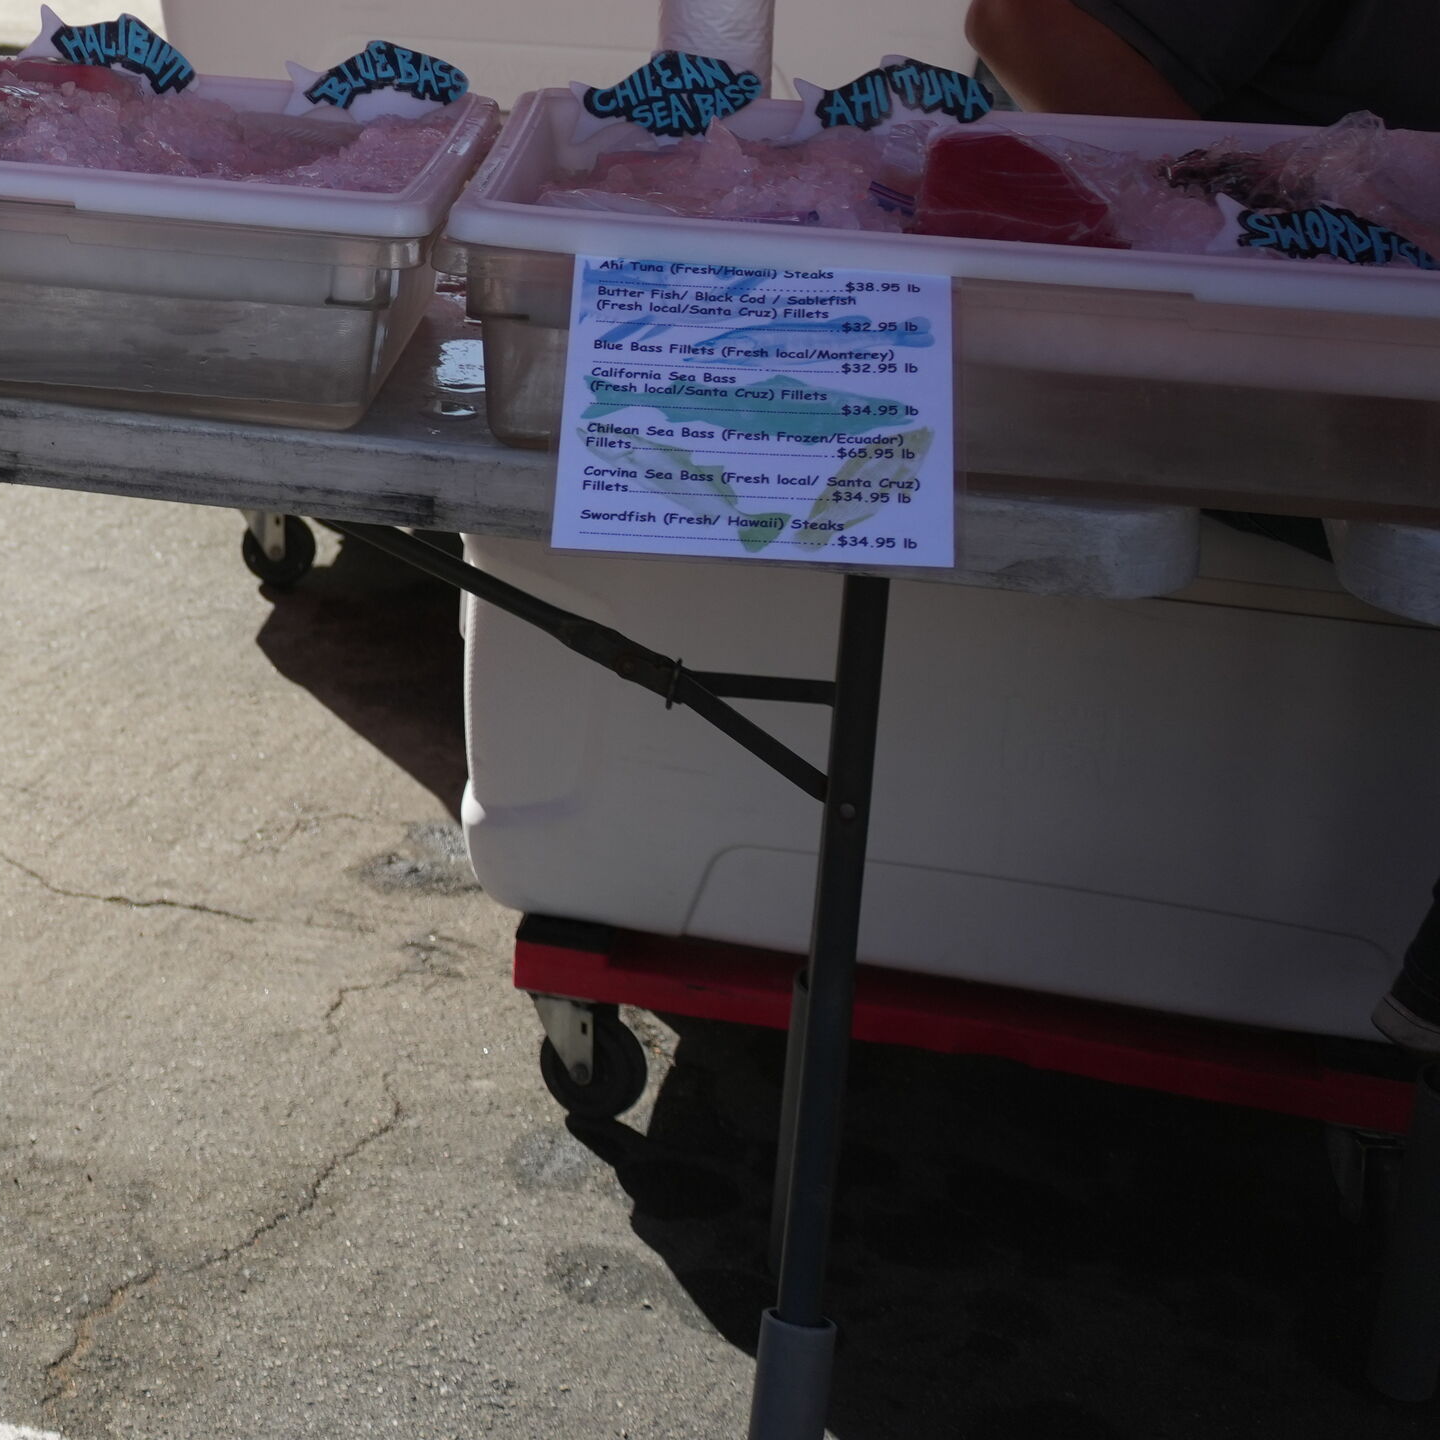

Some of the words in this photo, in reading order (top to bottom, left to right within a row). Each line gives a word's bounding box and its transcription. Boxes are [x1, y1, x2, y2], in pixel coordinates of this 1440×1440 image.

[61, 16, 195, 93] HALIBUT
[314, 44, 395, 107] BLUE
[394, 47, 469, 102] BASS
[591, 53, 729, 112] CHILEAN
[632, 97, 696, 130] SEA
[696, 73, 762, 128] BASS
[825, 73, 890, 127] AHI
[892, 68, 990, 120] TUNA
[628, 262, 666, 274] Tuna
[597, 286, 646, 299] Butter
[650, 289, 689, 301] Fish/
[694, 291, 735, 304] Black
[738, 294, 768, 305] Cod
[786, 294, 857, 307] Sablefish
[845, 281, 901, 293] $38.95
[841, 321, 899, 334] $32.95
[593, 340, 625, 352] Blue
[630, 342, 664, 355] Bass
[668, 343, 716, 356] Fillets
[720, 345, 770, 359] (Fresh
[775, 347, 895, 362] local/Monterey)
[591, 368, 663, 381] California
[668, 372, 697, 383] Sea
[703, 373, 737, 384] Bass
[841, 362, 899, 374] $32.95
[841, 404, 899, 417] $34.95
[586, 423, 641, 436] Chilean
[646, 426, 676, 438] Sea
[681, 426, 716, 439] Bass
[720, 429, 771, 443] (Fresh
[776, 432, 905, 447] Frozen/Ecuador)
[585, 437, 632, 449] Fillets
[837, 448, 895, 460] $65.95
[582, 480, 630, 493] Fillets
[831, 491, 891, 504] $34.95
[579, 510, 657, 525] Swordfish
[663, 512, 721, 528] (Fresh/
[727, 515, 786, 530] Hawaii)
[789, 519, 845, 532] Steaks
[837, 535, 899, 549] $34.95
